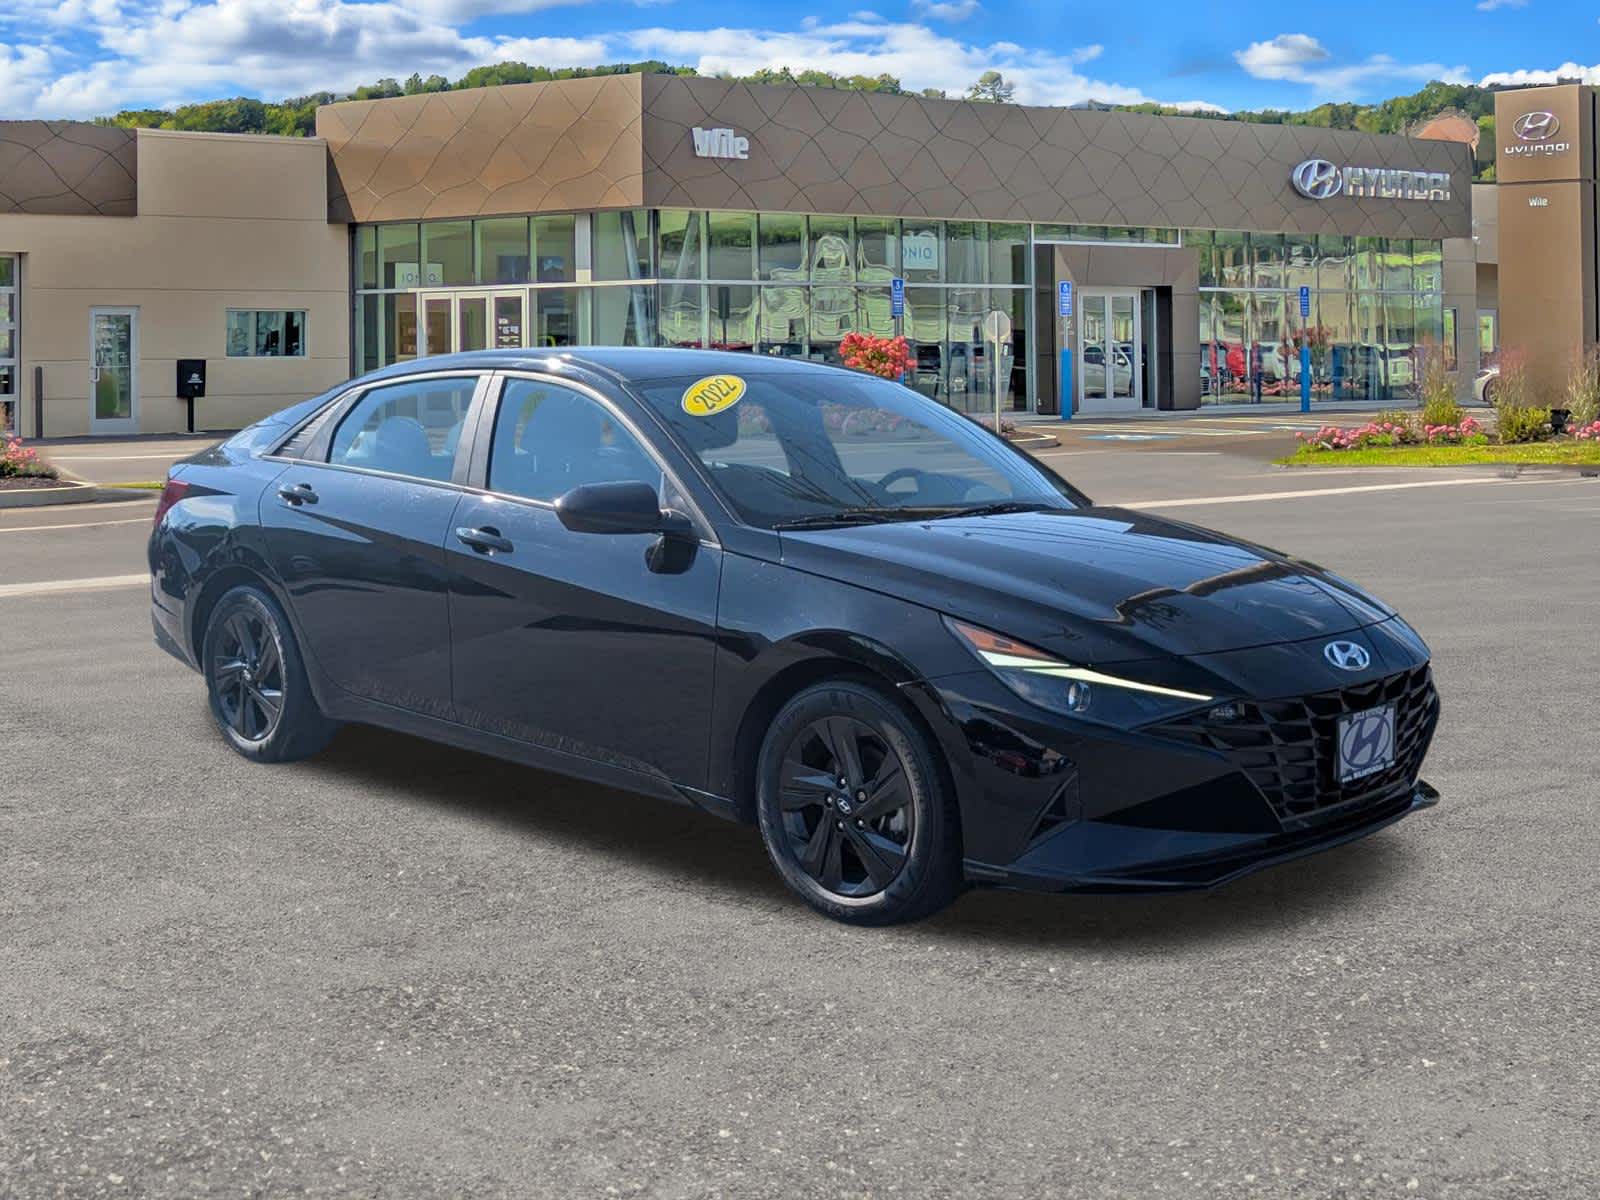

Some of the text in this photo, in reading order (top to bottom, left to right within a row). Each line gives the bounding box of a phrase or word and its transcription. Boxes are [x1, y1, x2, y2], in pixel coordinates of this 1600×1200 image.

[692, 127, 749, 160] Wile
[1342, 166, 1451, 201] HYUNDAI
[692, 378, 737, 411] 2022
